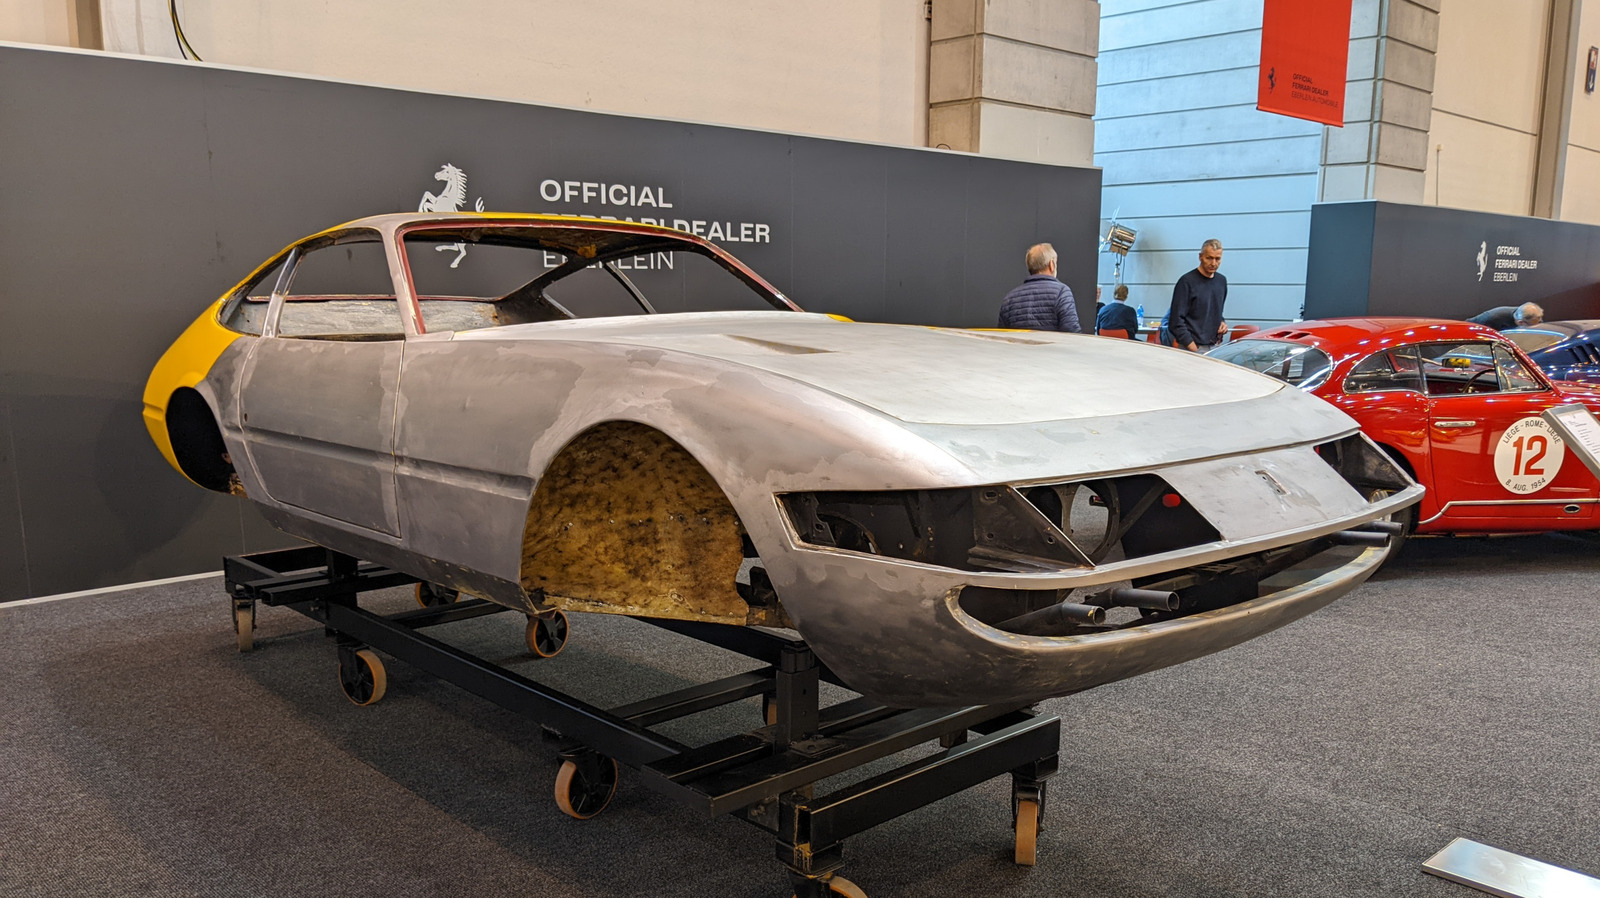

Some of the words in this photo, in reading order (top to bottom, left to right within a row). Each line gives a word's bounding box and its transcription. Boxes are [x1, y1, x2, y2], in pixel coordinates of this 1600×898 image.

[1292, 73, 1312, 84] OFFICIAL
[1292, 82, 1312, 92] FERRARI
[1312, 87, 1329, 96] DEALER
[540, 179, 673, 208] OFFICIAL
[673, 219, 770, 243] DEALER
[1497, 245, 1520, 256] OFFICIAL
[1495, 259, 1517, 269] FERRARI
[1518, 260, 1537, 269] DEALER
[1493, 272, 1518, 281] EBERLEIN
[1503, 425, 1520, 444] LIEGE
[1525, 420, 1544, 428] ROME
[1512, 435, 1547, 476] 12
[1505, 479, 1512, 487] 8.
[1513, 483, 1529, 491] AUG.
[1531, 477, 1546, 489] 1954
